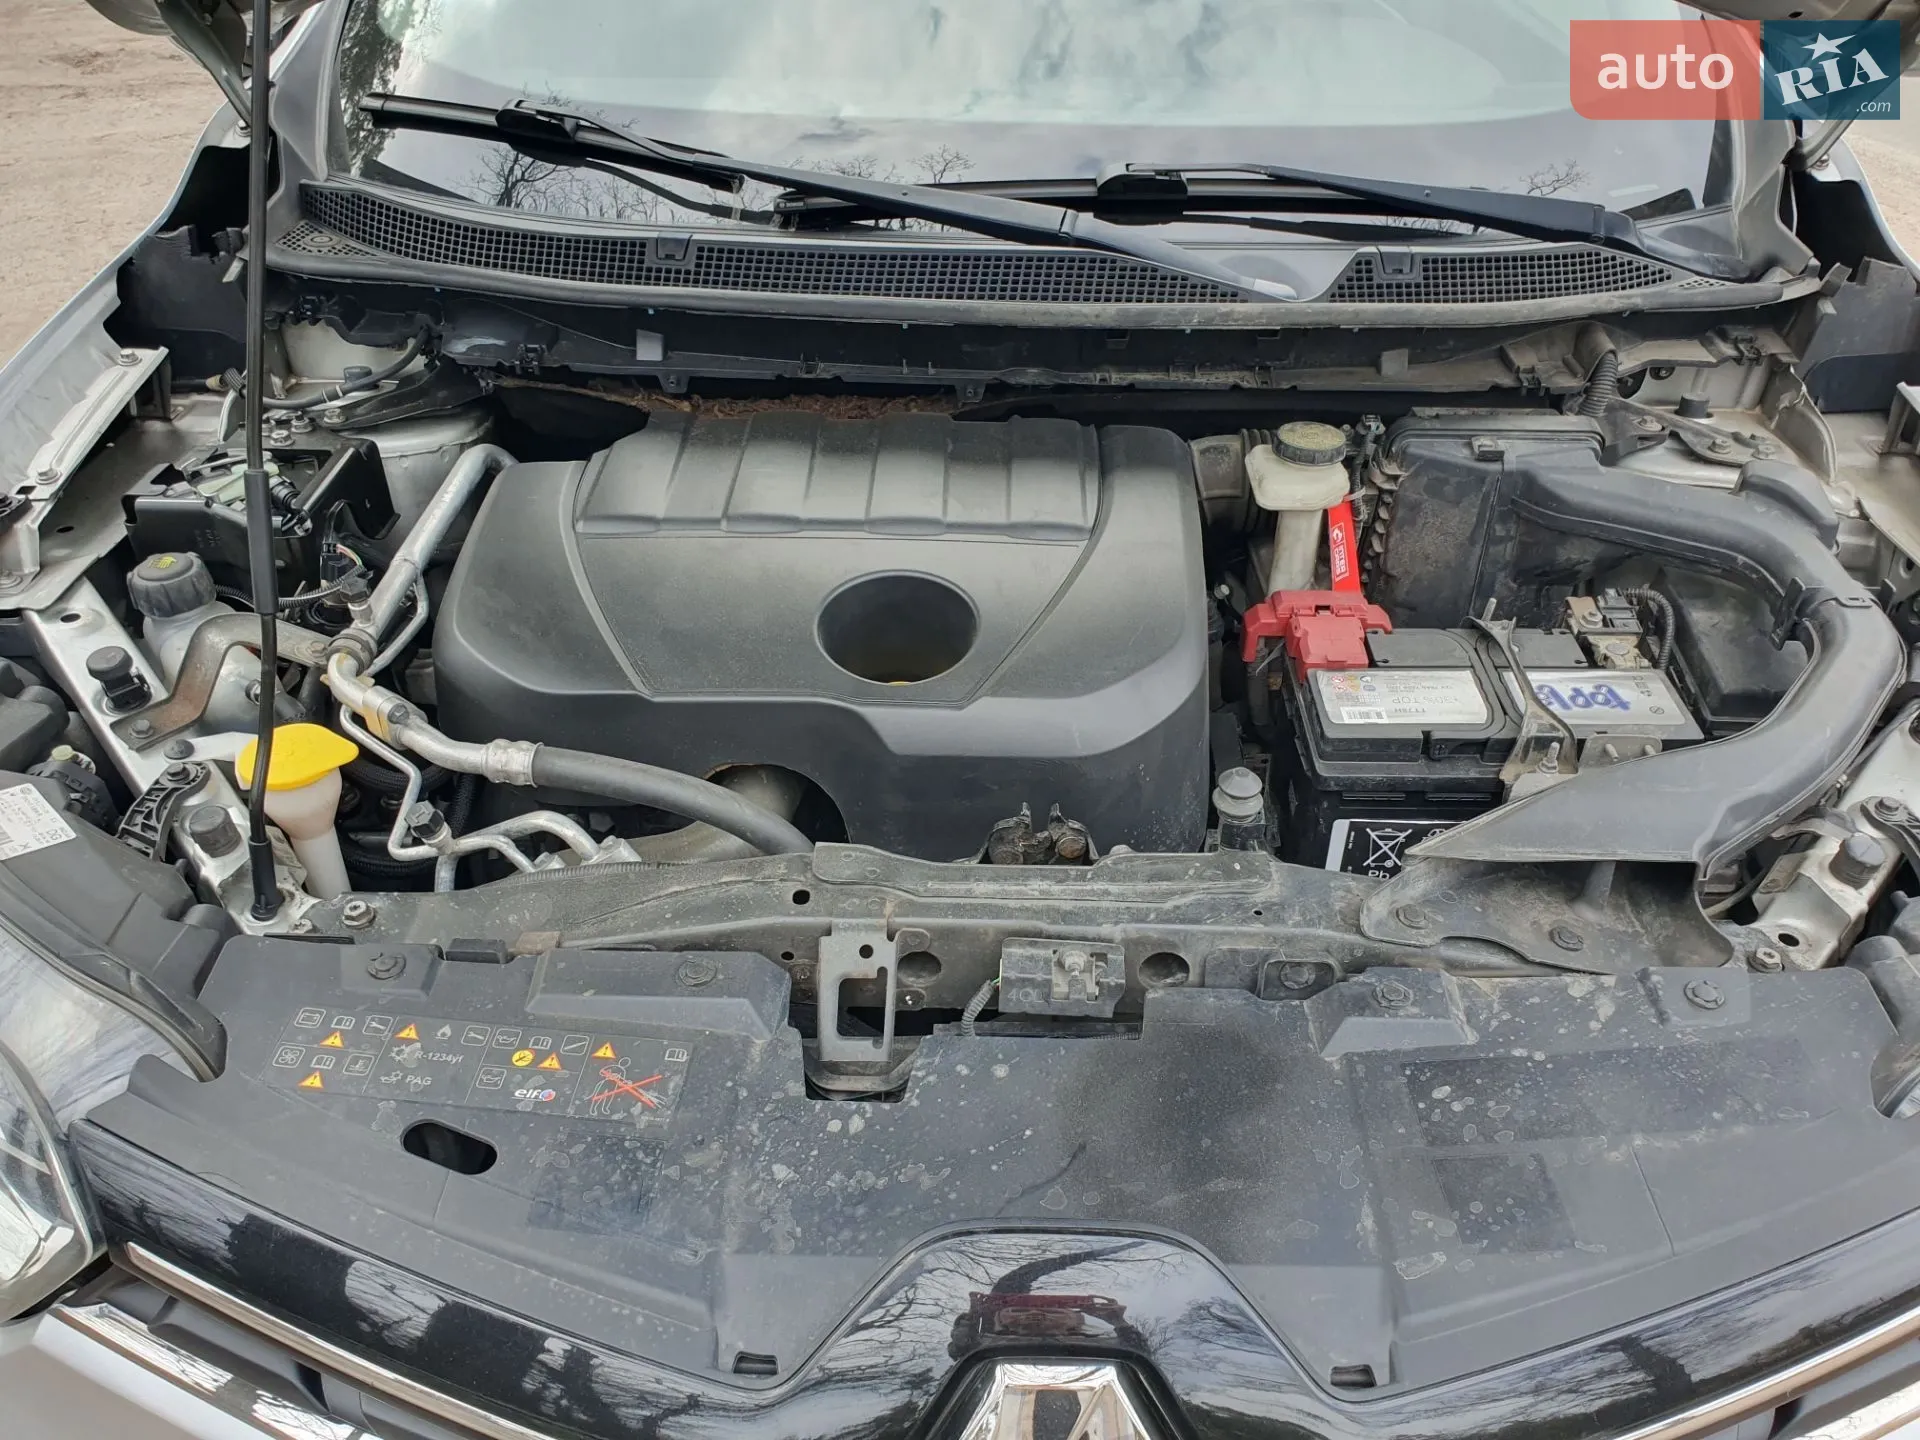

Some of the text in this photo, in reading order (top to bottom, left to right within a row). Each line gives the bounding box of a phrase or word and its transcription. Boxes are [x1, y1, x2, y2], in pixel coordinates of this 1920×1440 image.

[1368, 869, 1390, 880] Pb
[414, 1051, 465, 1064] R-1234yf
[405, 1075, 433, 1086] PAG
[513, 1088, 542, 1098] elf
